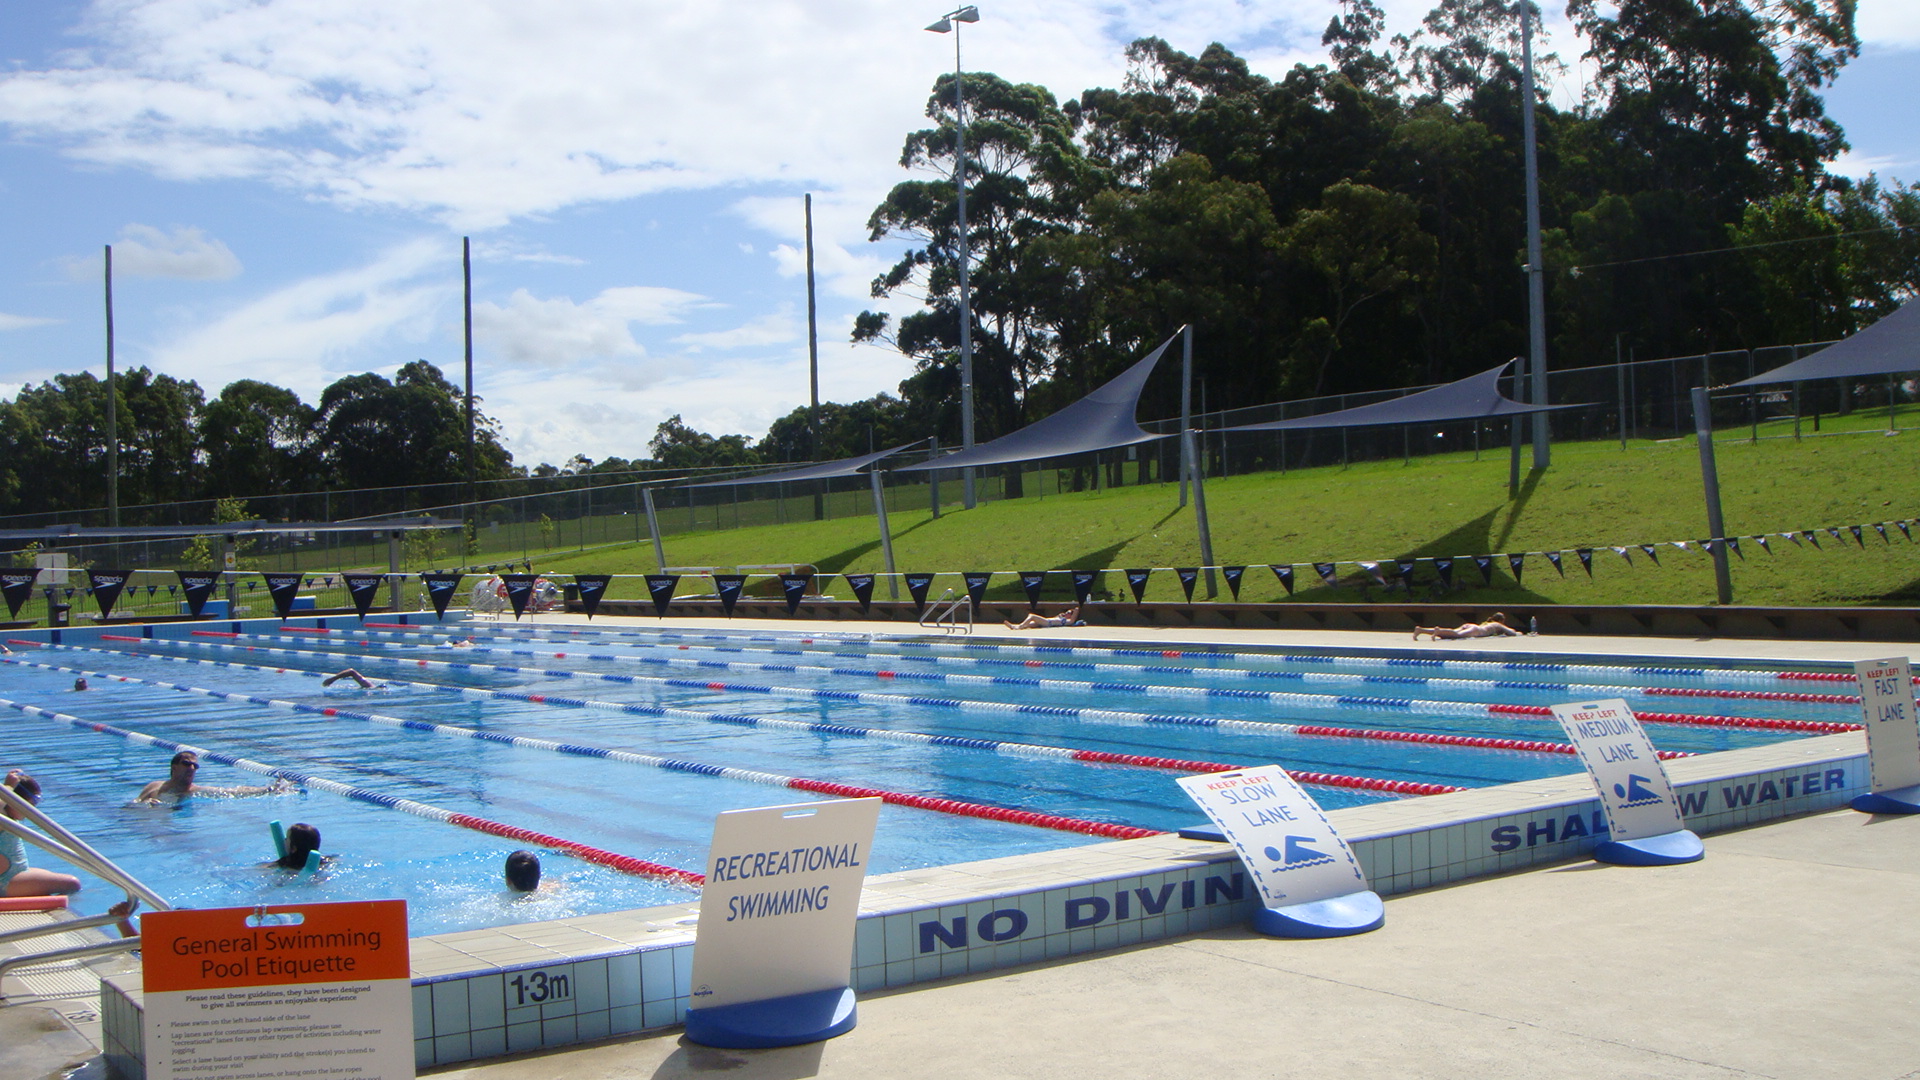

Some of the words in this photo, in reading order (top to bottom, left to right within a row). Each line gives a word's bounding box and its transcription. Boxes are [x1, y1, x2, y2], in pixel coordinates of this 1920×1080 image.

[2, 574, 32, 582] speedo
[93, 575, 123, 583] speedo
[1874, 678, 1899, 696] FAST
[1572, 712, 1594, 721] KEEP
[1596, 710, 1618, 718] LEFT
[1878, 703, 1905, 722] LANE
[1576, 718, 1634, 739] MEDIUM
[1598, 743, 1639, 763] LANE
[1206, 780, 1237, 790] KEEP
[1240, 776, 1270, 785] LEFT
[1722, 768, 1845, 809] WATER
[1220, 783, 1277, 804] SLOW
[1242, 806, 1298, 827] LANE
[713, 843, 860, 882] RECREATIONAL
[726, 885, 830, 922] SWIMMING
[919, 908, 1028, 954] NO
[1065, 872, 1258, 930] DIVIN
[172, 932, 258, 956] General
[265, 928, 380, 950] Swimming
[202, 957, 248, 978] Pool
[256, 956, 356, 978] Etiquette
[210, 1002, 224, 1010] give
[285, 996, 318, 1005] enjoyable
[320, 995, 357, 1003] experience
[248, 990, 285, 1000] guidelines,
[340, 986, 371, 994] designed
